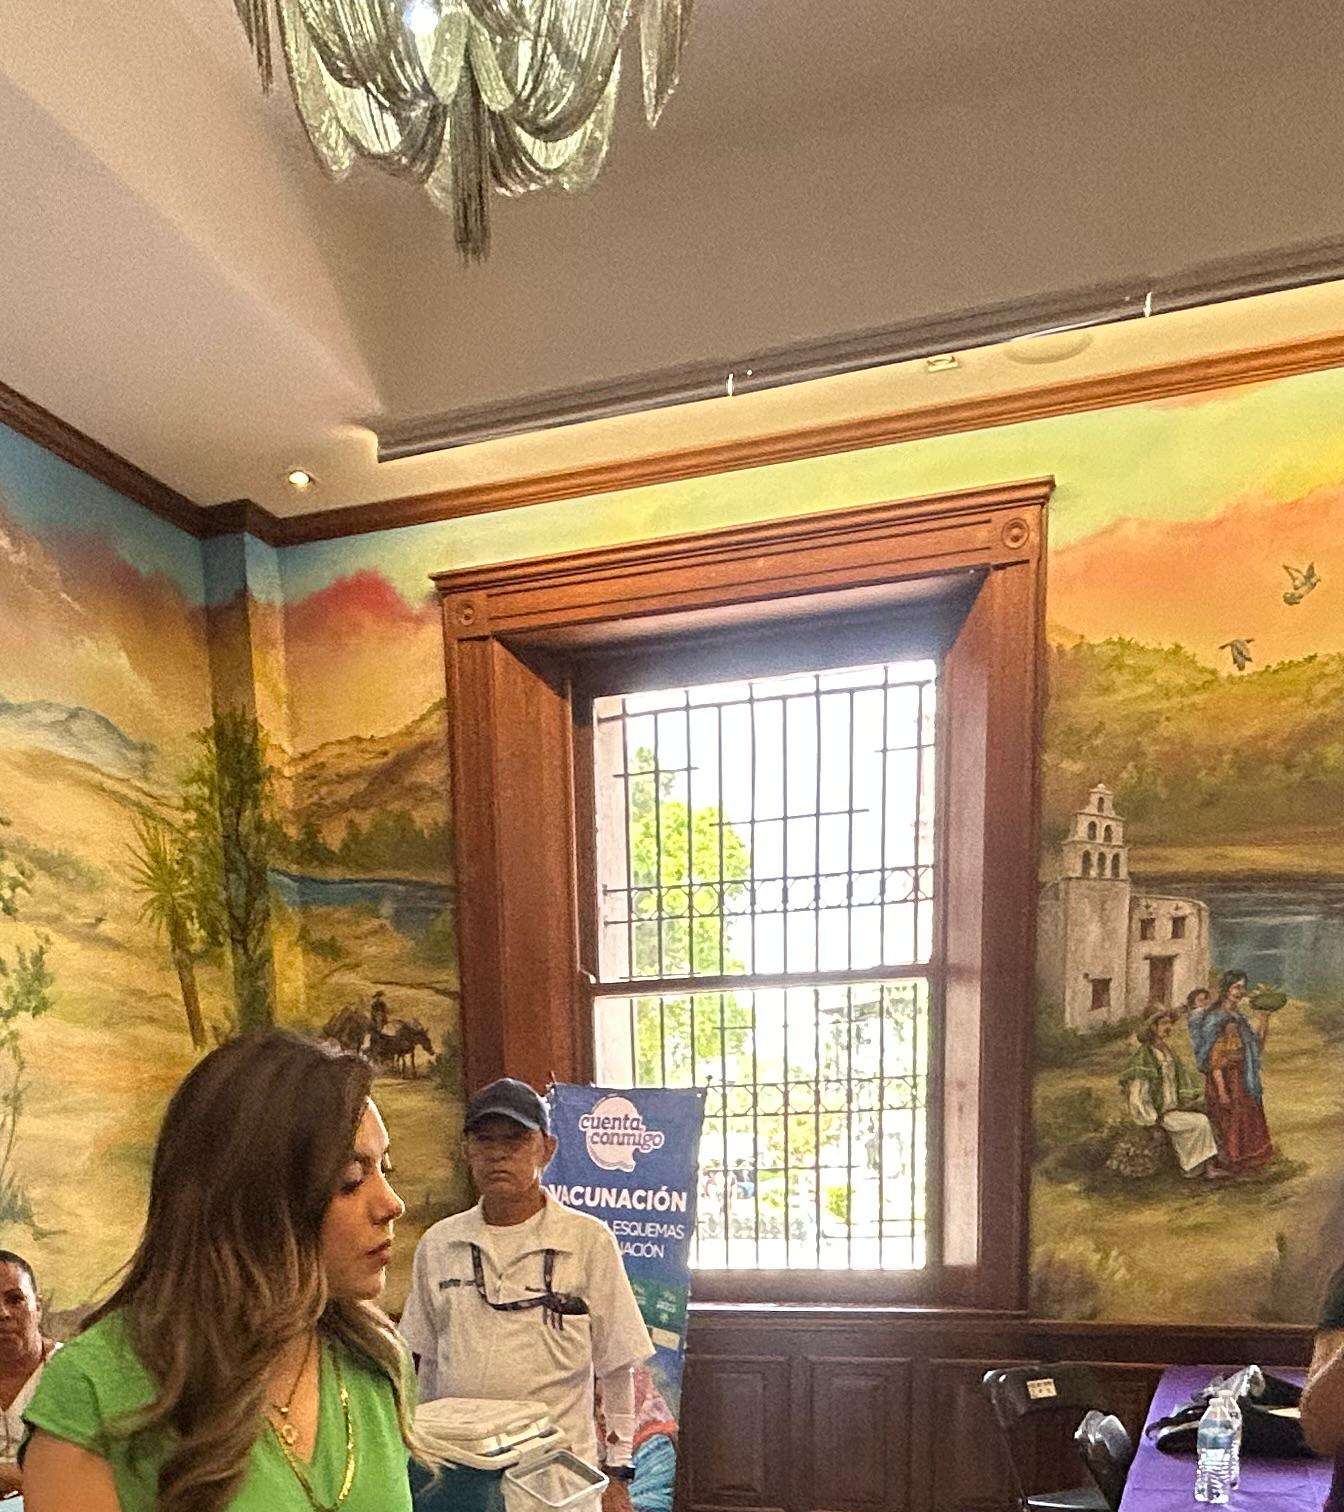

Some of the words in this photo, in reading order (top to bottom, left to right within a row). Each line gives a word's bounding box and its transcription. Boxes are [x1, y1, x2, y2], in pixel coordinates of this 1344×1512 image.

[581, 1114, 642, 1131] cuenta
[590, 1131, 663, 1151] conmigo
[613, 1220, 685, 1240] ESQUEMAS
